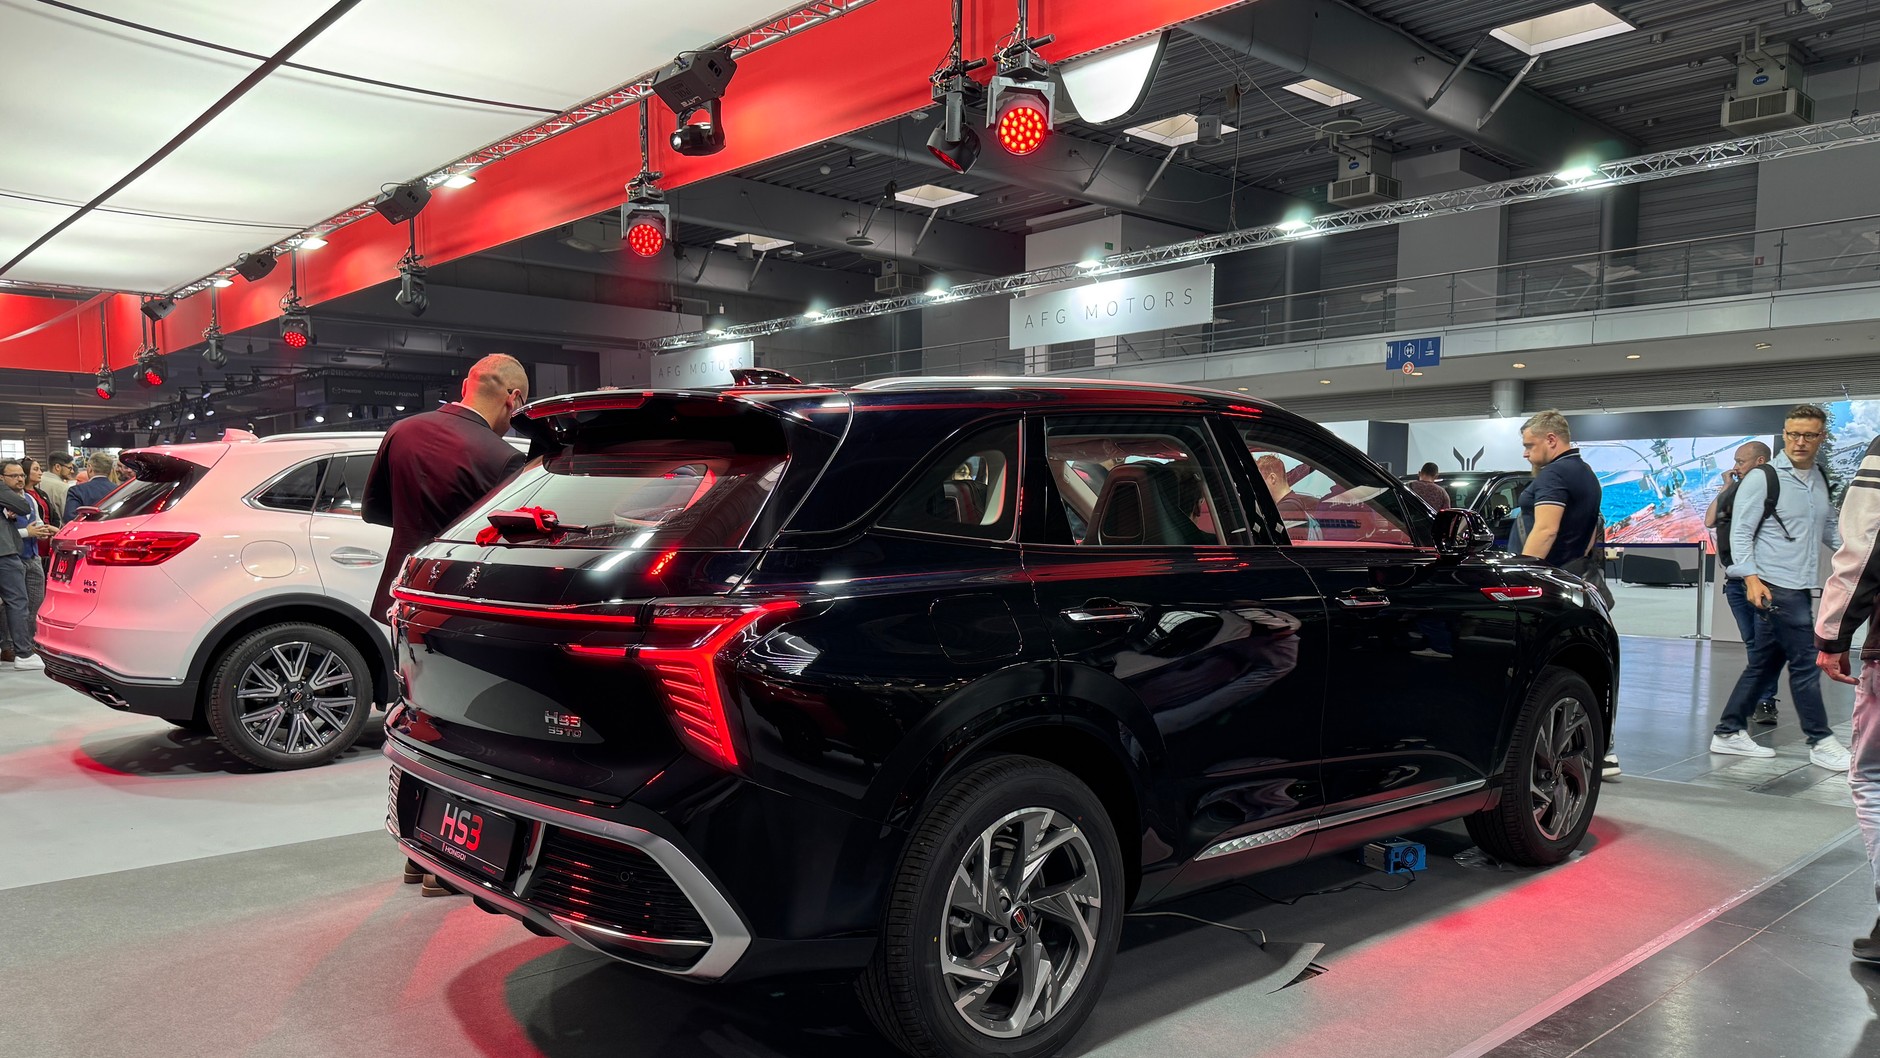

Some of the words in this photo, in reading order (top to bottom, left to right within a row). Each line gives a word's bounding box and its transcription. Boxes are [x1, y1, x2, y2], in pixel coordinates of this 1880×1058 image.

[1024, 309, 1066, 329] AFG
[1085, 288, 1193, 320] MOTORS
[658, 365, 681, 378] AFG
[689, 357, 744, 374] MOTORS
[544, 710, 582, 727] HS3
[440, 802, 484, 851] HS3
